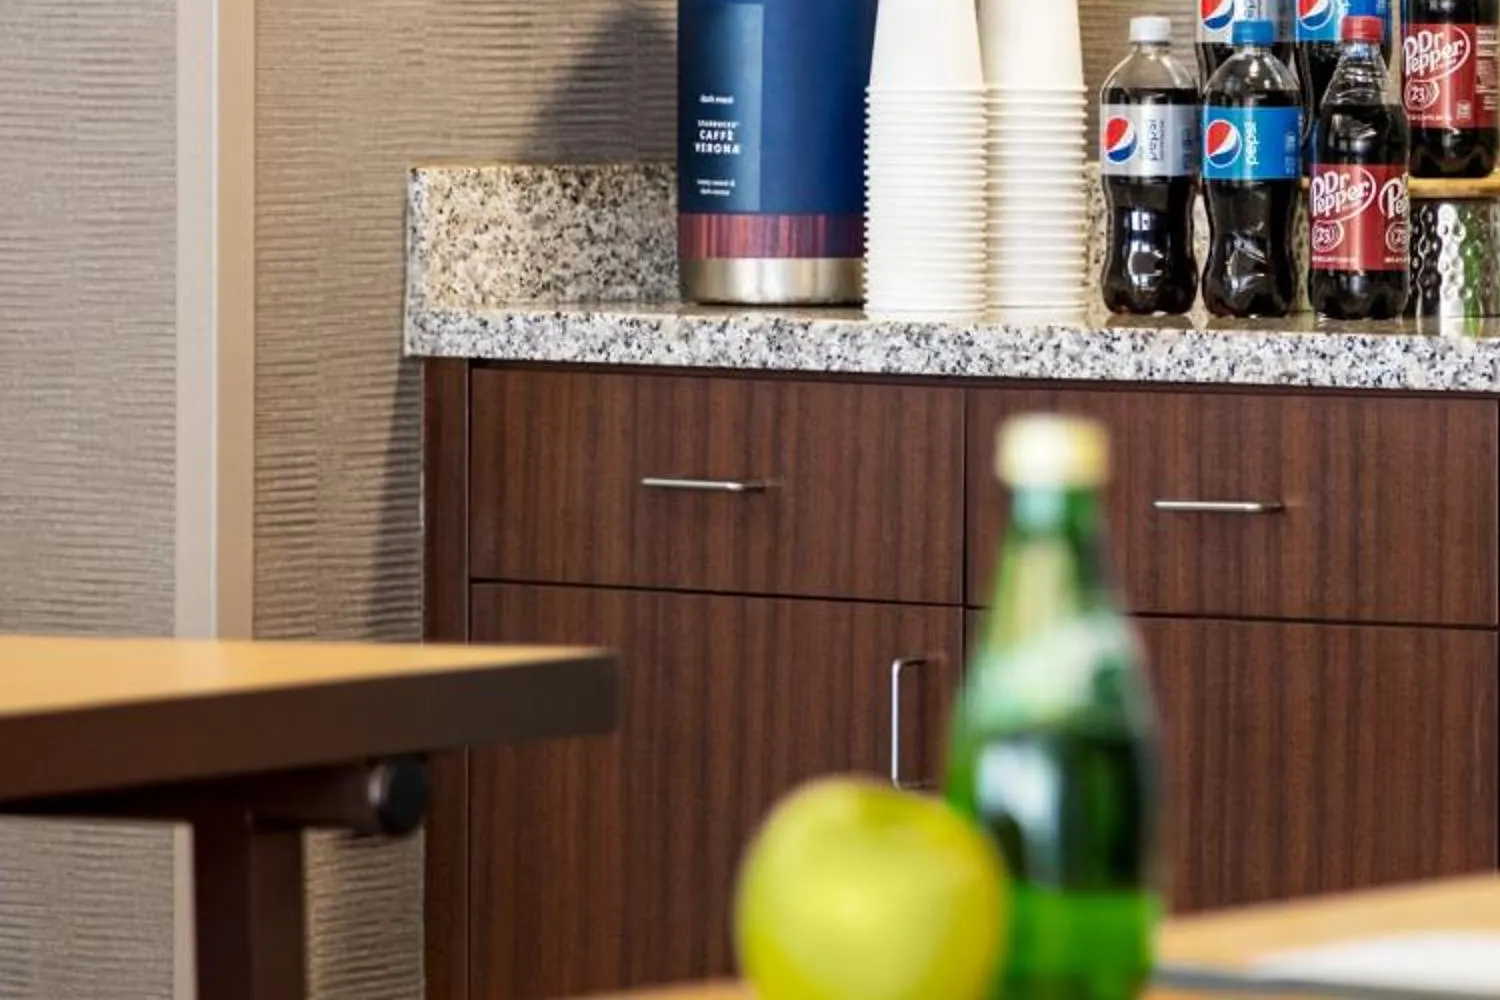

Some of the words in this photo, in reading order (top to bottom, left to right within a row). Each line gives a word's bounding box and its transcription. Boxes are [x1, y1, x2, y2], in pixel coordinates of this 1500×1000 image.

[1418, 30, 1444, 53] Dr
[1404, 36, 1464, 76] Pepper
[695, 143, 741, 155] VERONA
[1324, 171, 1350, 194] Dr
[1312, 176, 1370, 217] Pepper
